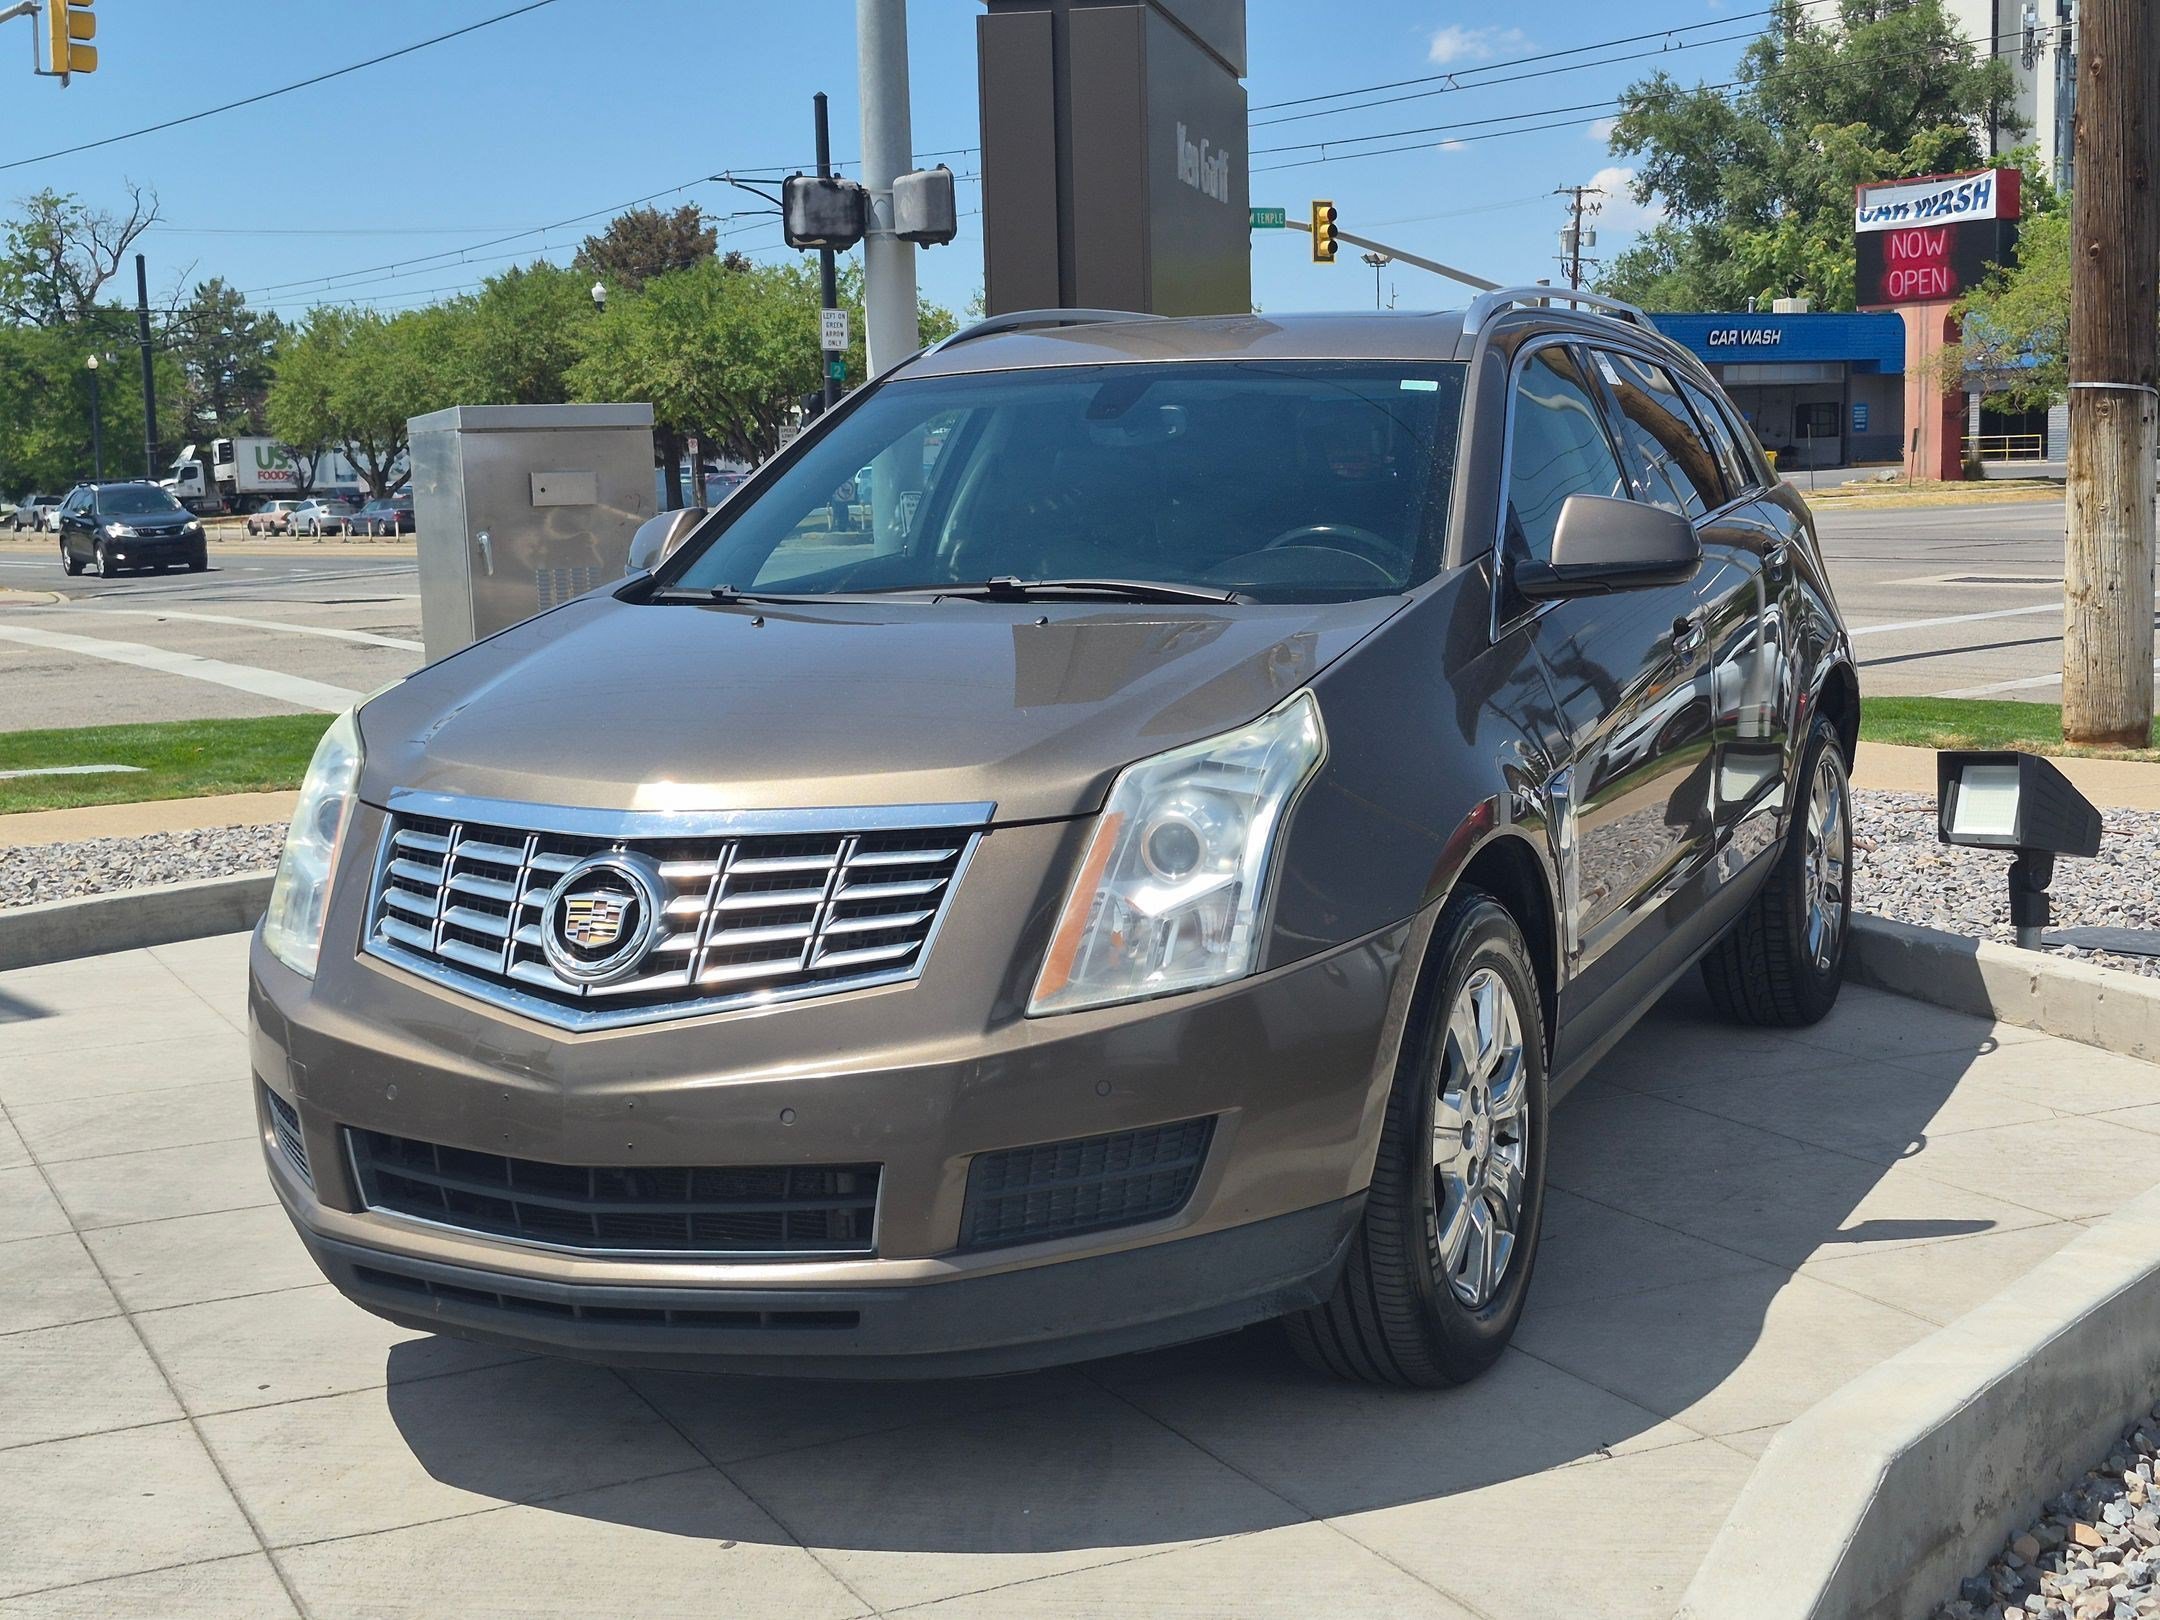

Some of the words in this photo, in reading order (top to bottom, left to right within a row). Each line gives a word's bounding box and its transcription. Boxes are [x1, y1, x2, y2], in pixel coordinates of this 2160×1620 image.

[1913, 179, 1992, 218] WASH
[1257, 212, 1284, 224] TEMPLE
[1891, 229, 1945, 260] NOW
[1888, 267, 1947, 297] OPEN
[1709, 330, 1737, 346] CAR
[1740, 329, 1781, 345] WASH
[834, 365, 841, 378] 2
